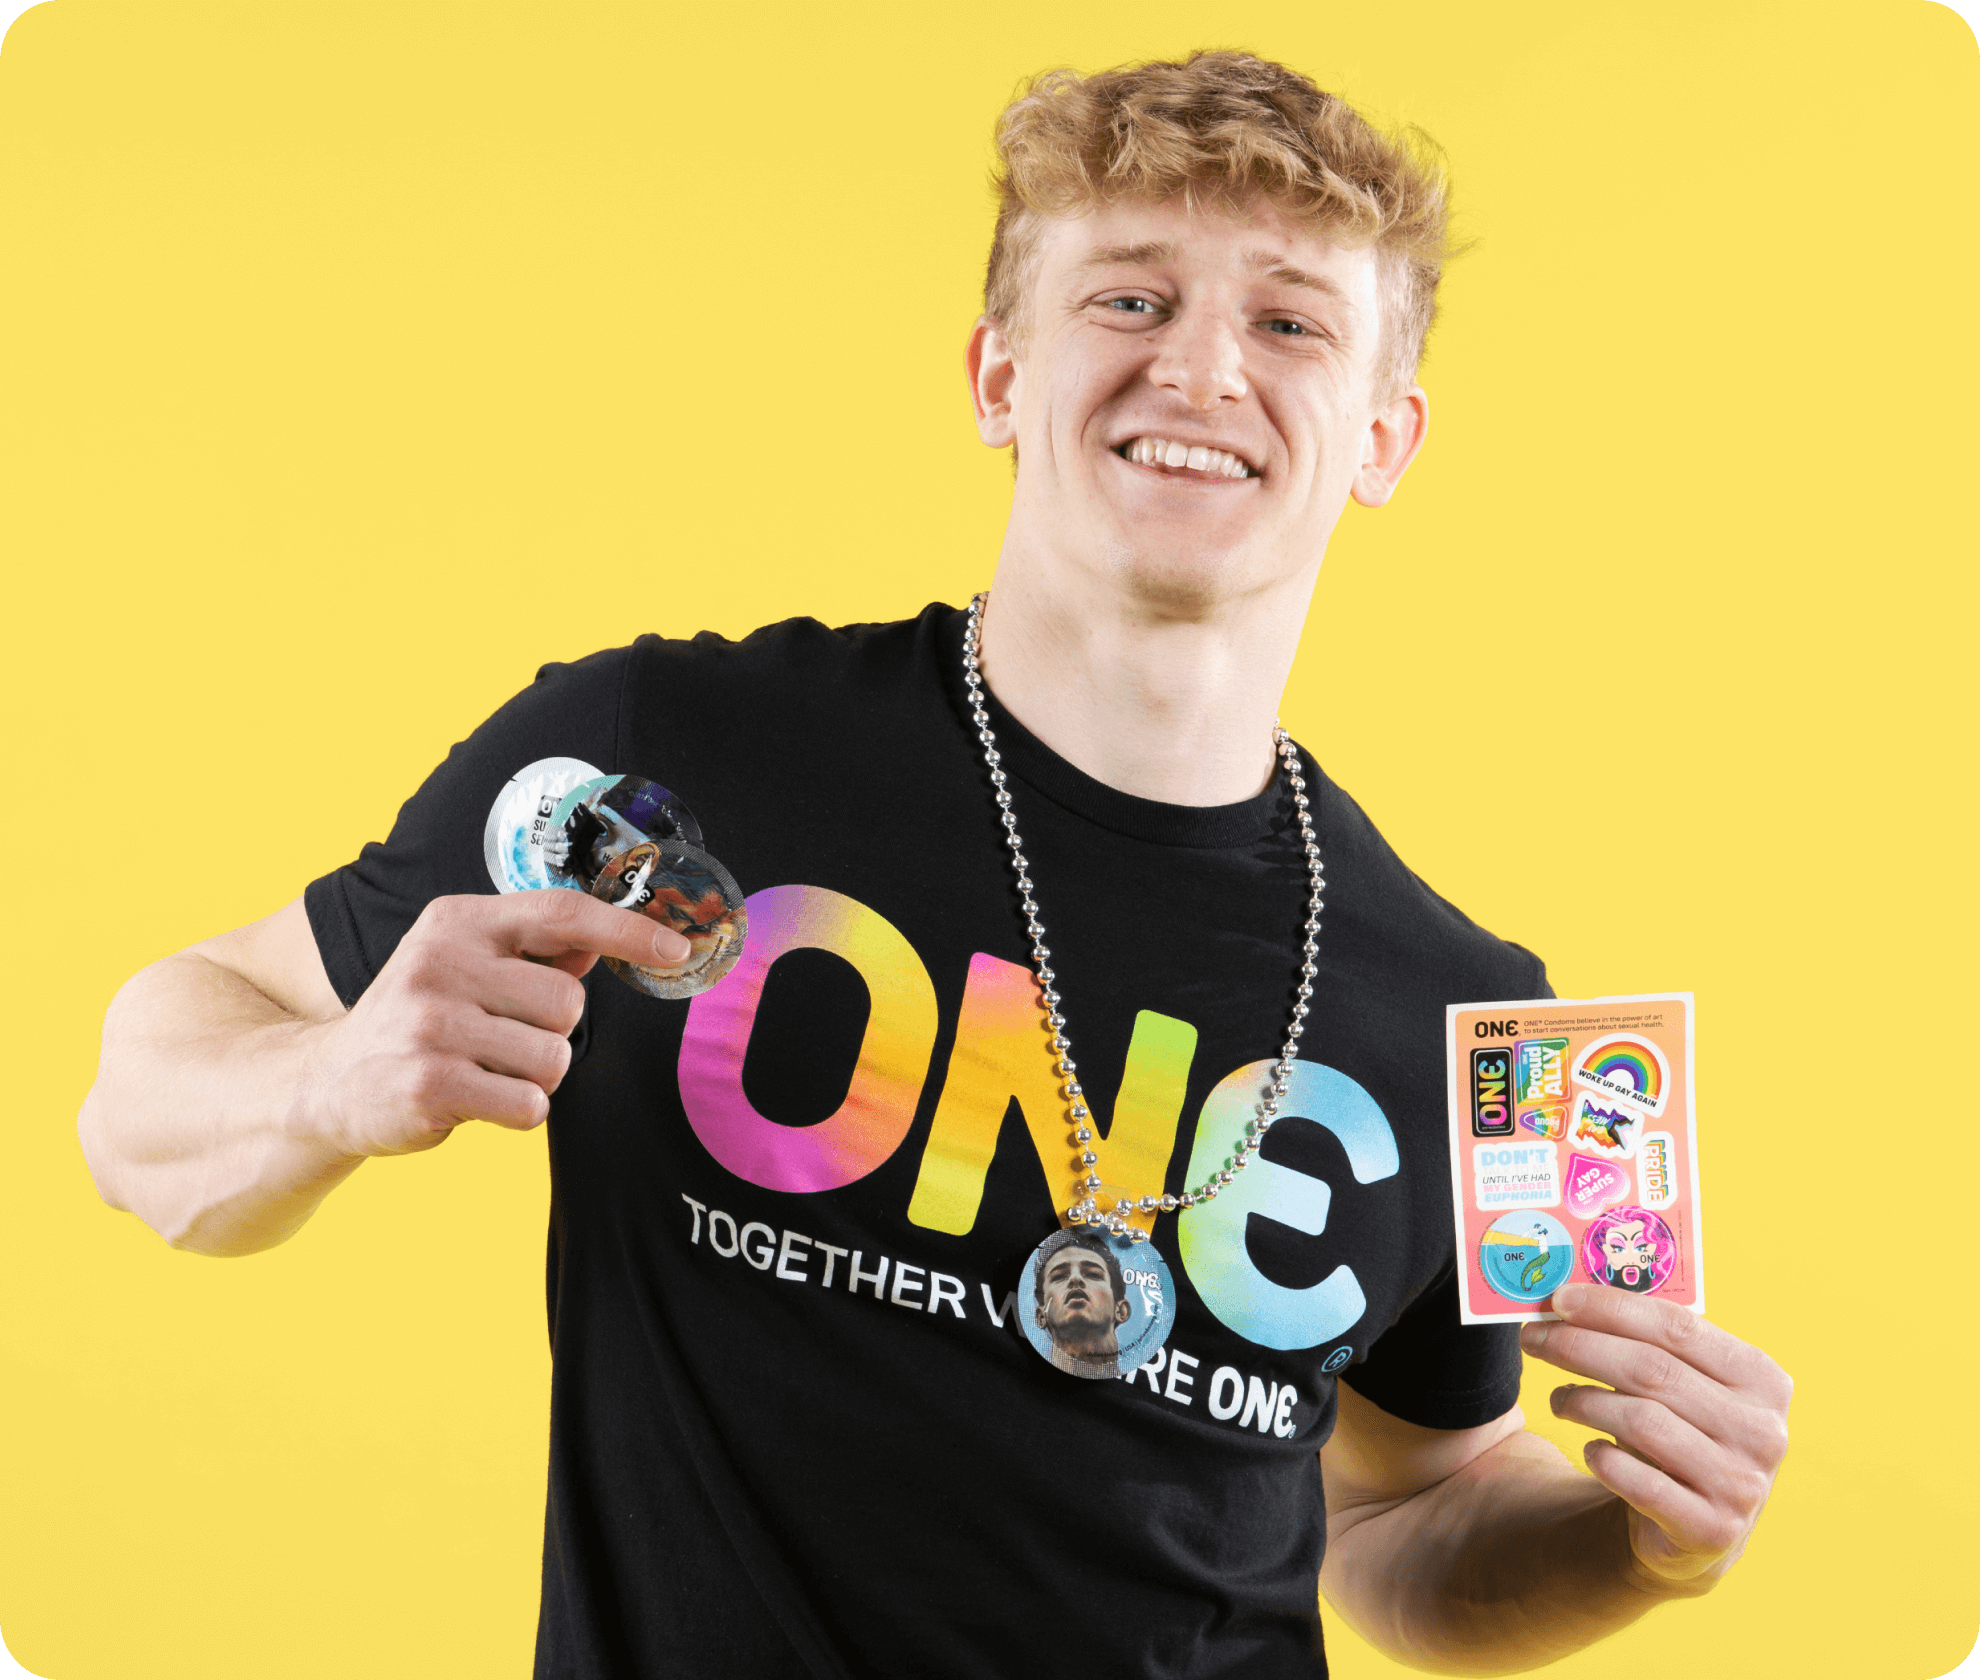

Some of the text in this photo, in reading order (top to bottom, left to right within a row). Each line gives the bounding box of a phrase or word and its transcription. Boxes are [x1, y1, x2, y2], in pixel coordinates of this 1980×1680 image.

[1474, 1019, 1519, 1038] ONE
[1544, 1018, 1575, 1026] Condoms
[1622, 1015, 1643, 1023] power
[1550, 1025, 1596, 1033] conversations
[1527, 1046, 1544, 1099] Proud
[1544, 1046, 1563, 1096] ALLY
[1478, 1058, 1508, 1126] ONE
[1578, 1069, 1602, 1084] WOKE
[1602, 1079, 1615, 1088] UP
[1615, 1085, 1632, 1096] GAY
[1632, 1092, 1658, 1108] AGAIN
[678, 884, 1399, 1350] ONE
[1481, 1148, 1549, 1167] DON'T
[1482, 1173, 1551, 1185] UNTIL I'VE HAD
[1576, 1167, 1600, 1188] GAY
[1644, 1141, 1666, 1203] PRIDE
[1483, 1181, 1552, 1192] MY GENDER
[1484, 1190, 1552, 1203] EUPHORIA
[1574, 1173, 1614, 1202] SUPER
[1504, 1251, 1526, 1262] ONE
[1640, 1254, 1661, 1264] ONE
[682, 1193, 967, 1319] TOGETHER
[981, 1283, 1024, 1338] W
[1116, 1344, 1200, 1406] RE
